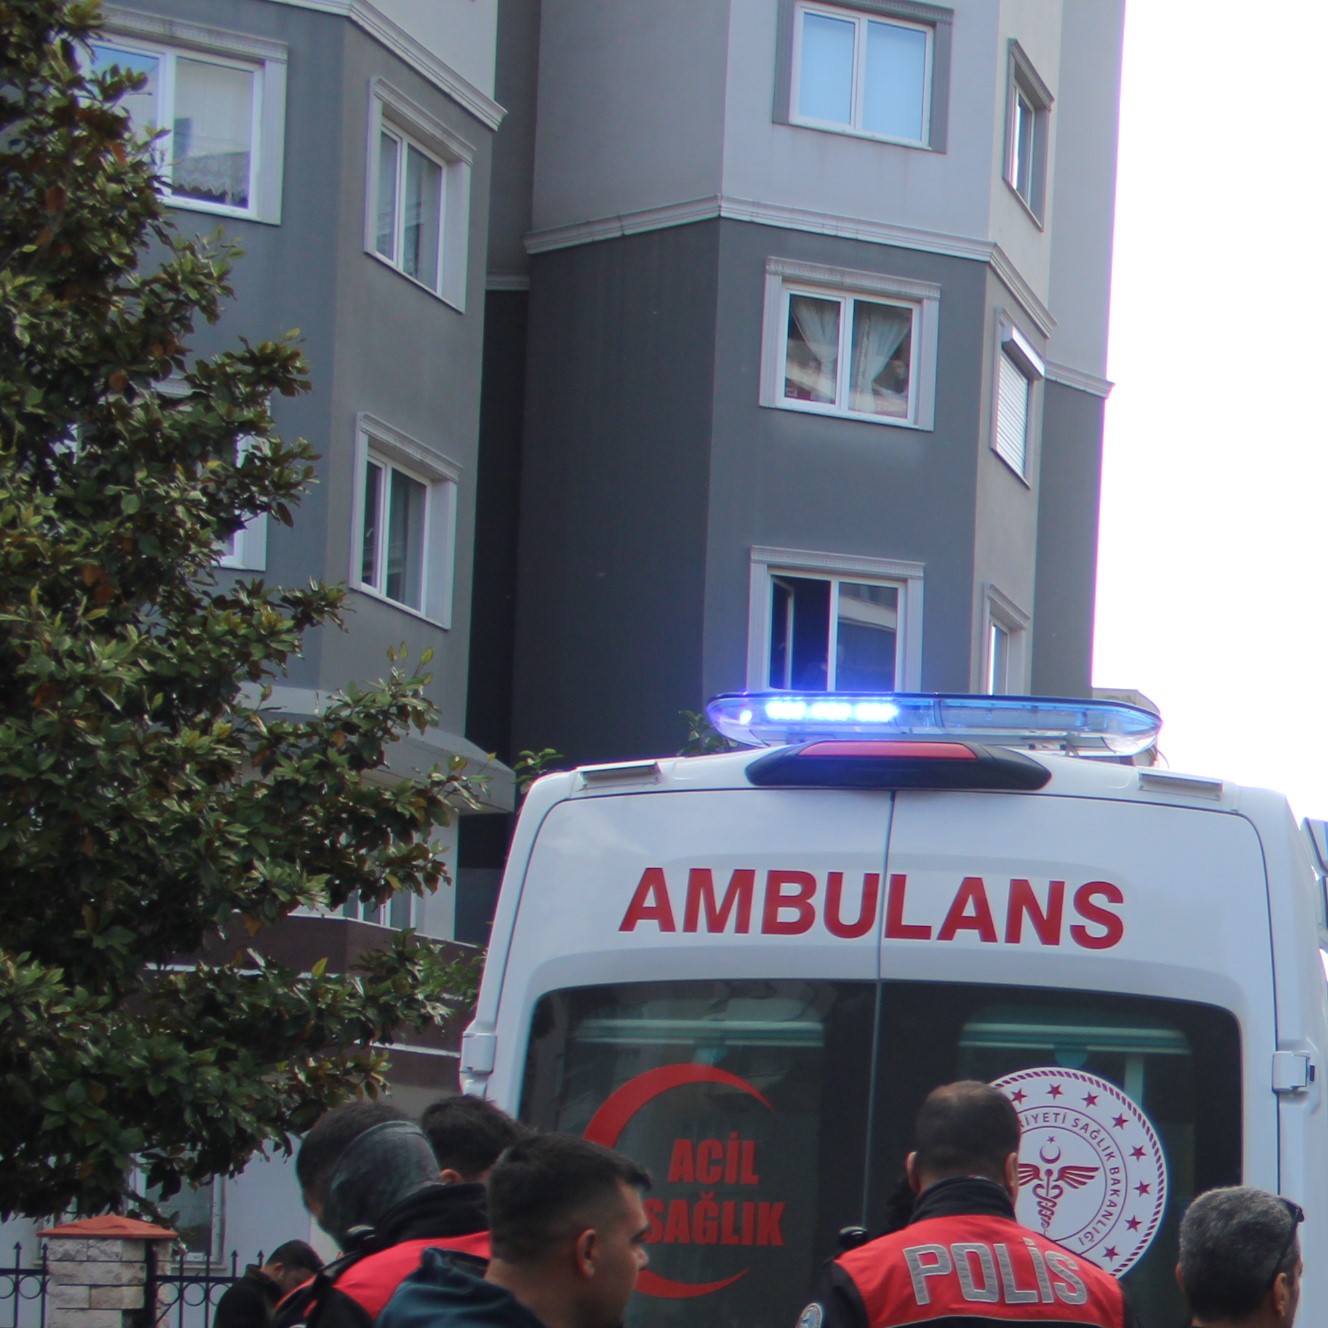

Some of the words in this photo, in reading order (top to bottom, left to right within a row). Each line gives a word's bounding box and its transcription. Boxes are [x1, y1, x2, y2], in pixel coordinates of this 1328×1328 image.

[618, 867, 1124, 950] AMBULANS
[667, 1131, 759, 1185] ACİL
[1072, 1117, 1117, 1162] SAĞLIK
[646, 1189, 787, 1246] SAĞLIK
[1078, 1166, 1122, 1247] BAKANLIĞI
[903, 1237, 1088, 1305] POLİS
